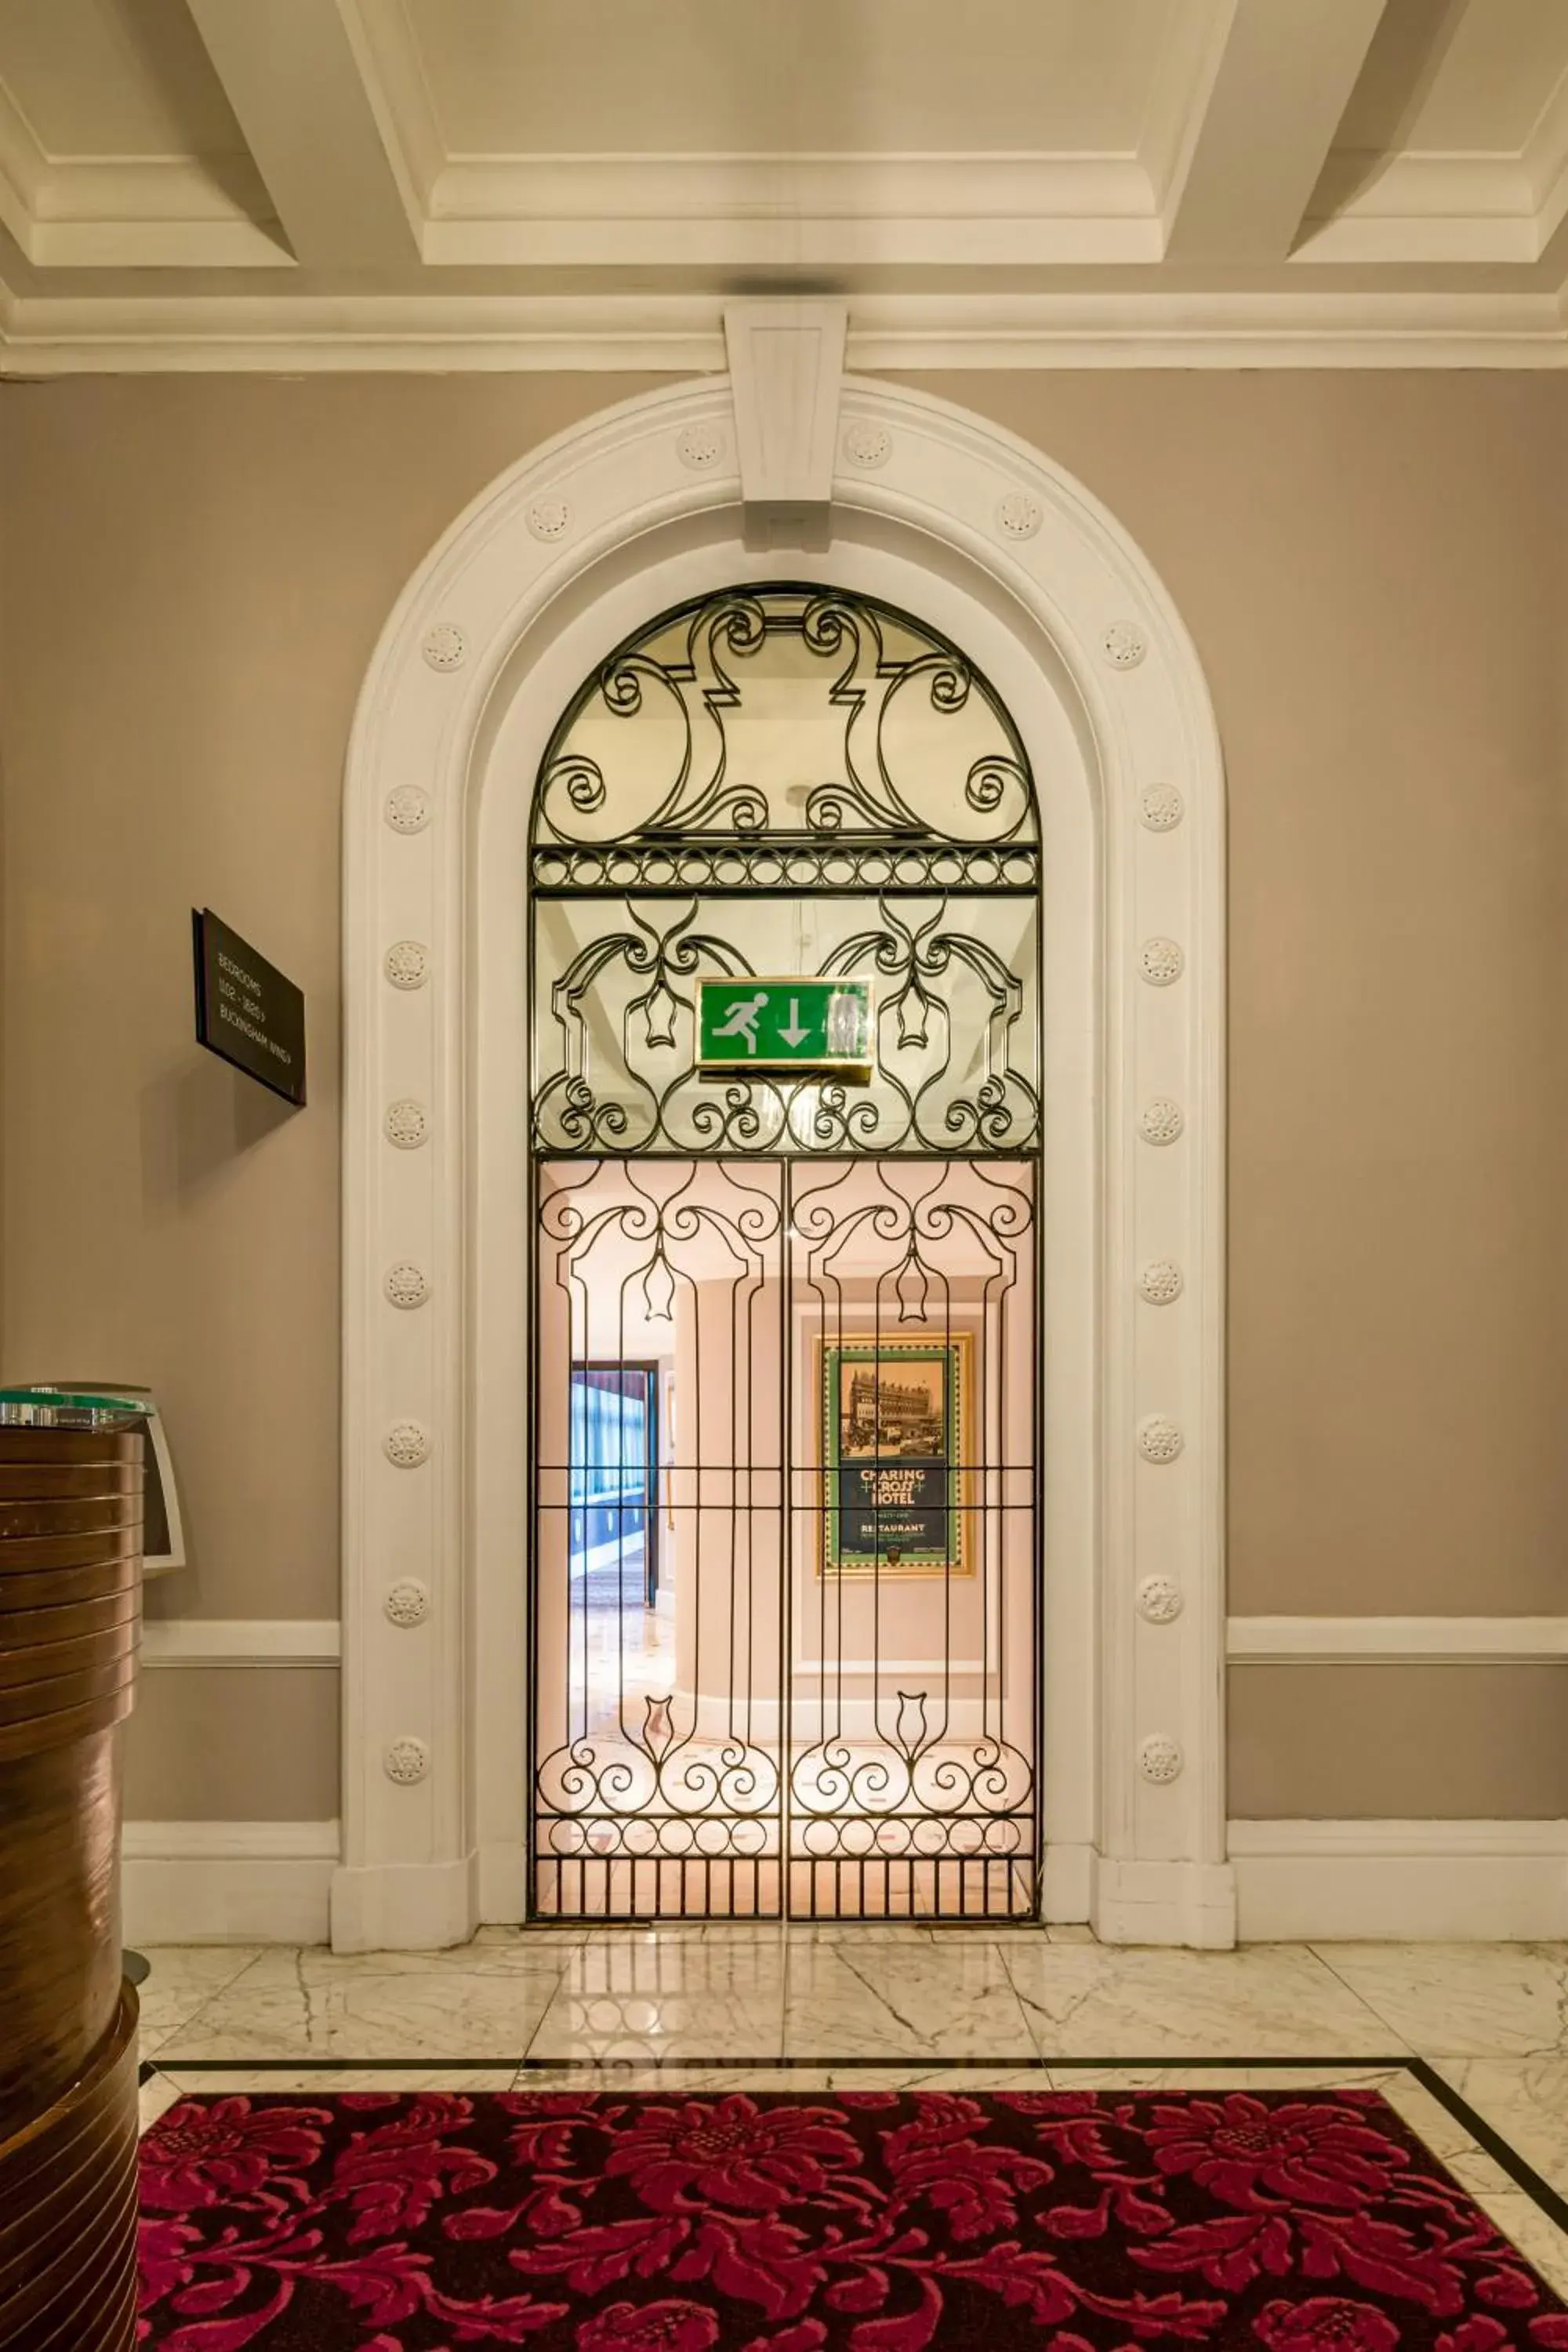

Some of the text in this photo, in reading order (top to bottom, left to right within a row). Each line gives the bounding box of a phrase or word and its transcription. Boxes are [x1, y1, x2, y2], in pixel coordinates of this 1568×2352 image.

[219, 953, 261, 997] BEDROOMS
[220, 1004, 268, 1048] BUCKINGHAM
[860, 1469, 925, 1481] CHARING
[873, 1481, 914, 1492] CROSS
[872, 1492, 915, 1504] HOTEL
[861, 1524, 925, 1533] RETAURANT
